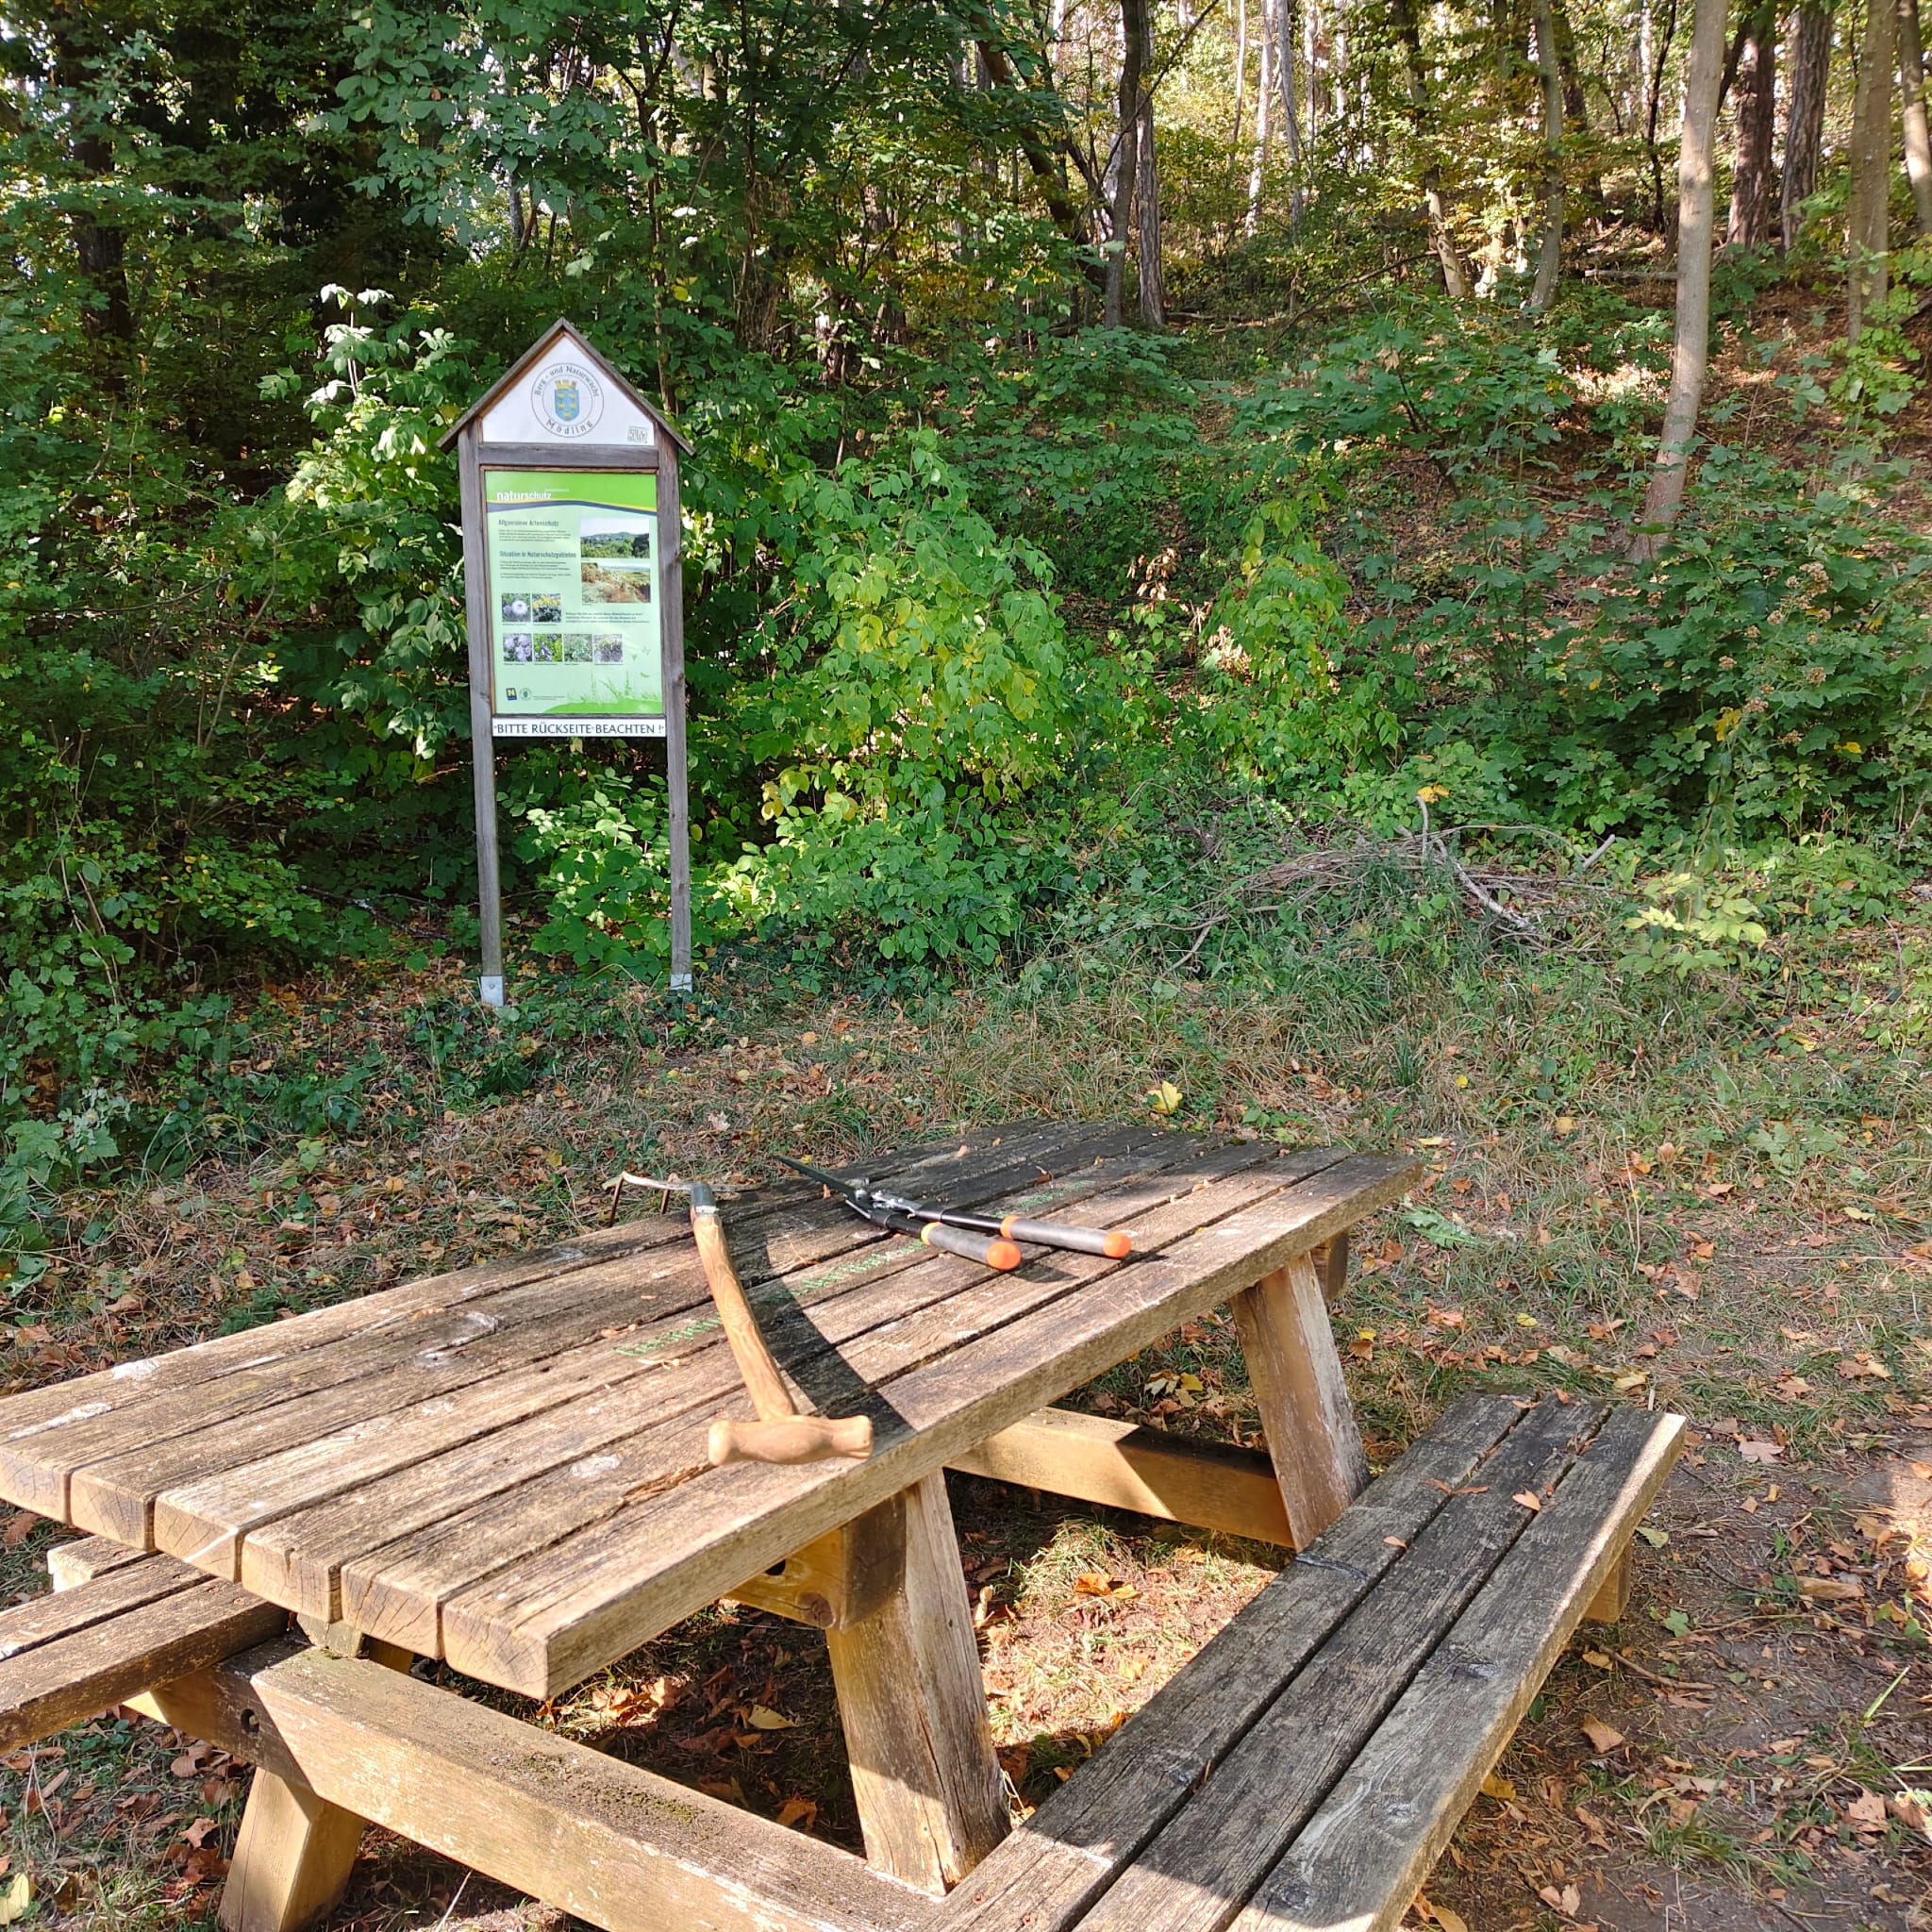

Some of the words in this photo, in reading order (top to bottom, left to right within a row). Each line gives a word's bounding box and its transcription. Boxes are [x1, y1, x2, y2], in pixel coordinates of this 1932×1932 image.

[549, 366, 563, 376] und
[566, 365, 599, 397] Naturwacht
[496, 490, 552, 501] naturschutz
[497, 724, 528, 734] BITTE
[532, 721, 592, 734] RÜCKSEITE
[595, 724, 655, 734] BEACHTEN
